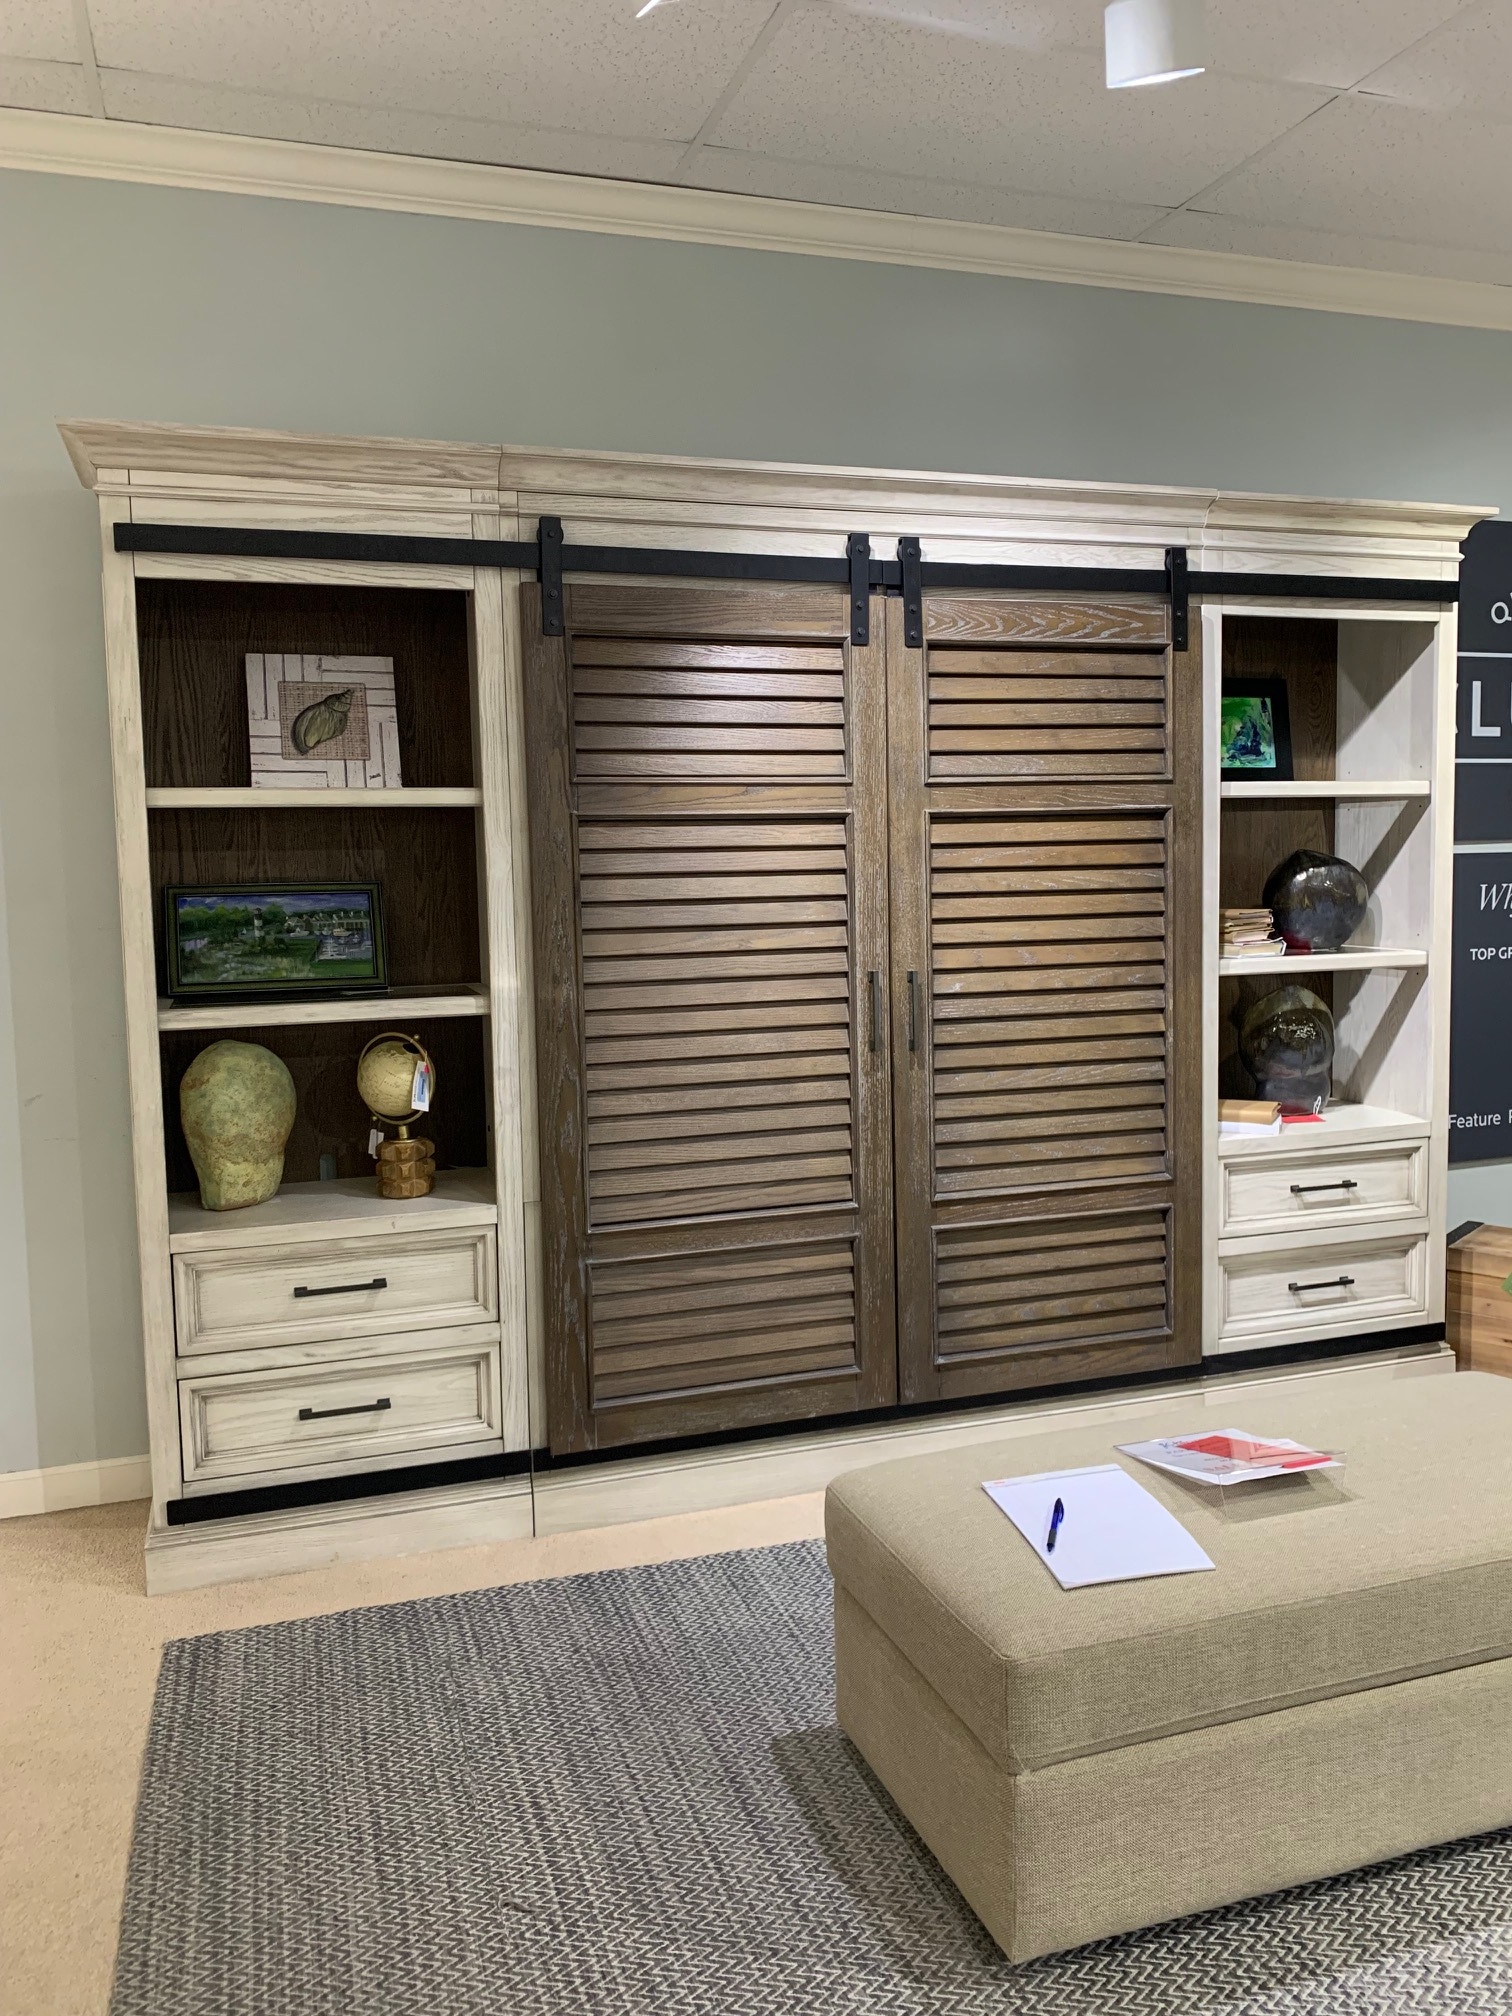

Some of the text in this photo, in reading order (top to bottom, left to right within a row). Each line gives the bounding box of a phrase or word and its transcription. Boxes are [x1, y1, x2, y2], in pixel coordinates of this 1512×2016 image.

[1491, 592, 1512, 624] Q
[1480, 883, 1512, 918] Wh
[1469, 947, 1496, 960] TOP
[1448, 1113, 1501, 1129] Feature
